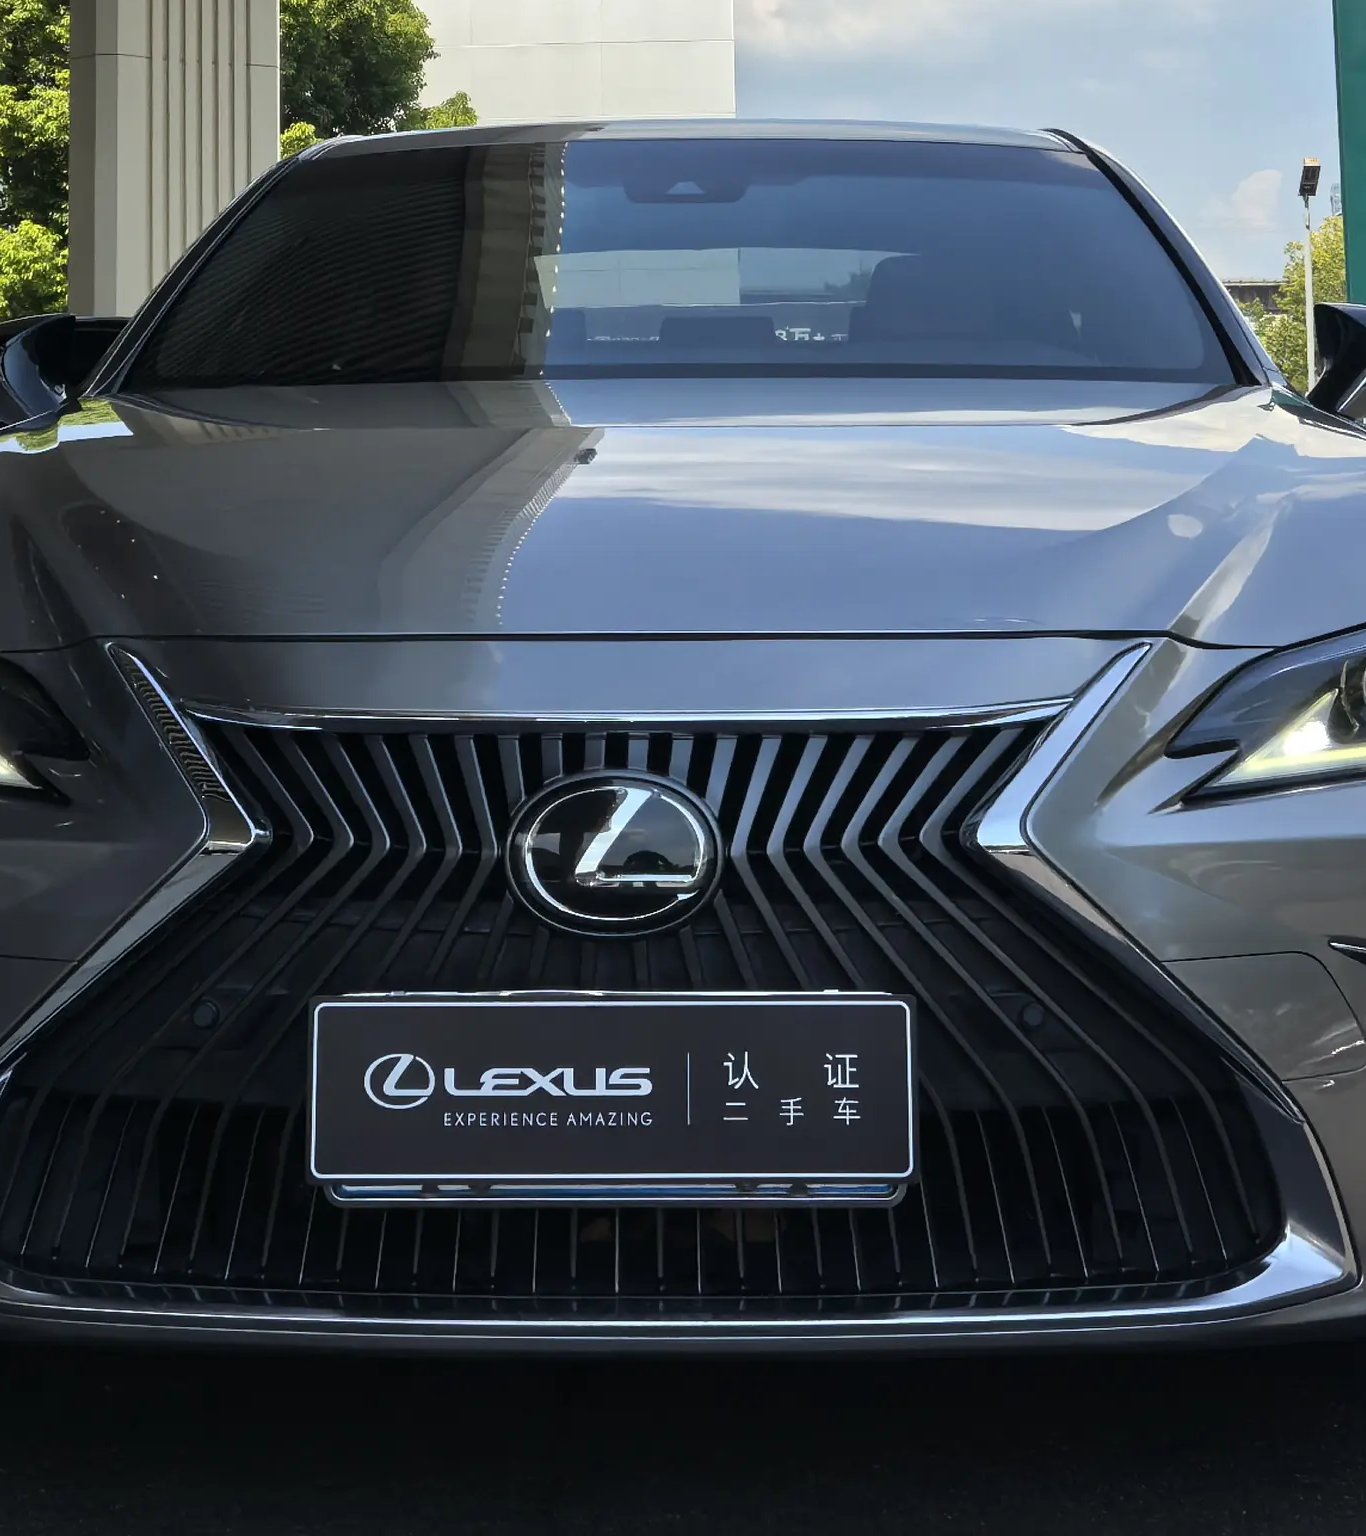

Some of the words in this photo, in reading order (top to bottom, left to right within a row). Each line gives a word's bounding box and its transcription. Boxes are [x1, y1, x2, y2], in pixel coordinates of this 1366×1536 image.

[443, 1067, 653, 1097] LEXUS
[443, 1112, 558, 1127] EXPERIENCE
[566, 1111, 654, 1126] AMAZING
